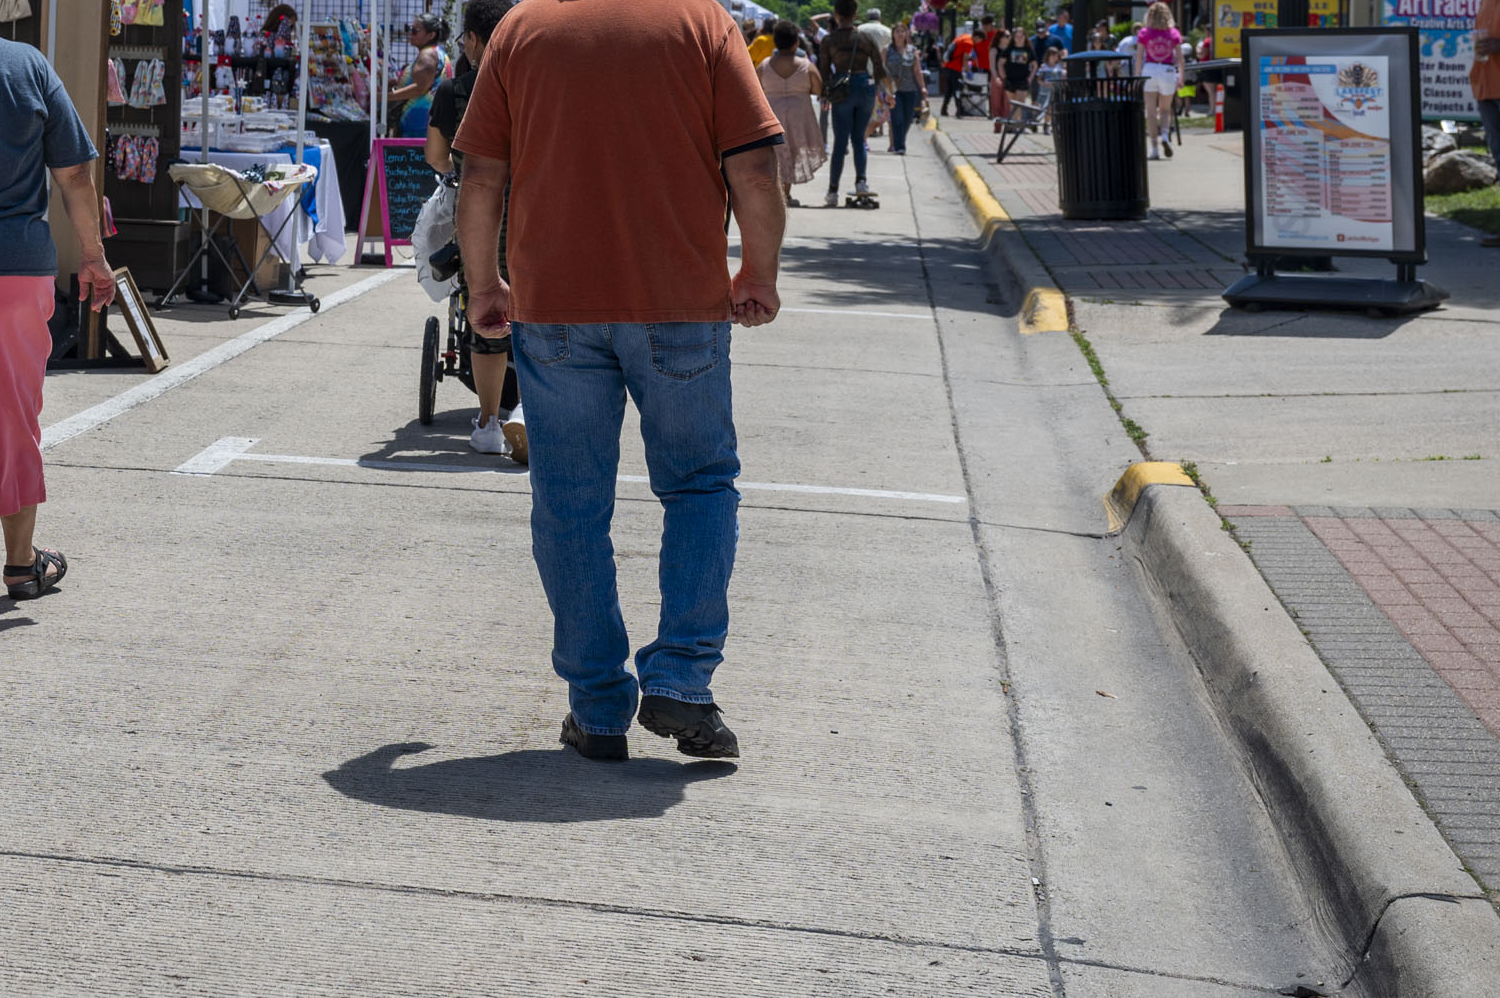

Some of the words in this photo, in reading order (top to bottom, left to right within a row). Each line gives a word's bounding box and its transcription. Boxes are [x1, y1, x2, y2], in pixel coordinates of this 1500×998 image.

[1410, 17, 1445, 30] Creative
[1446, 18, 1465, 29] Arts
[1438, 62, 1466, 71] Room
[1435, 75, 1470, 85] Activit
[1424, 88, 1463, 98] Classes
[1423, 101, 1464, 113] Projects
[385, 149, 407, 163] Lemon
